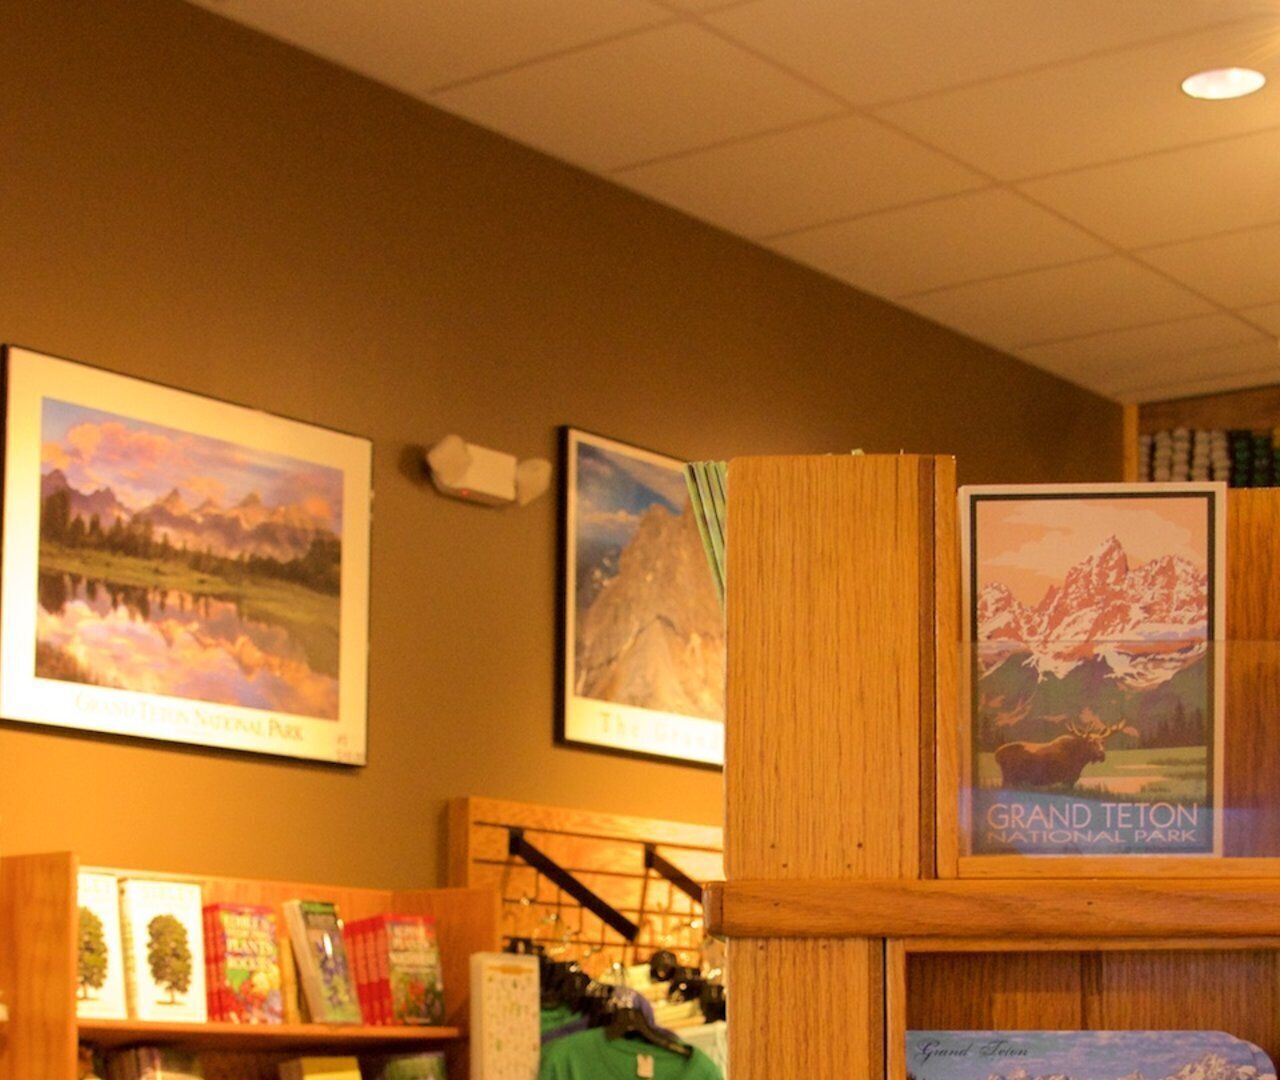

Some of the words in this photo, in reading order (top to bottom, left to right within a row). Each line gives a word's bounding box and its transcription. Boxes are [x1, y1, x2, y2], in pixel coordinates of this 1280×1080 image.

[268, 718, 305, 743] PARK
[987, 802, 1092, 829] GRAND
[1101, 802, 1198, 829] TETON
[987, 829, 1127, 844] NATIONAL
[1135, 829, 1197, 843] PARK
[913, 1038, 974, 1067] Grand
[980, 1040, 1028, 1058] Teton
